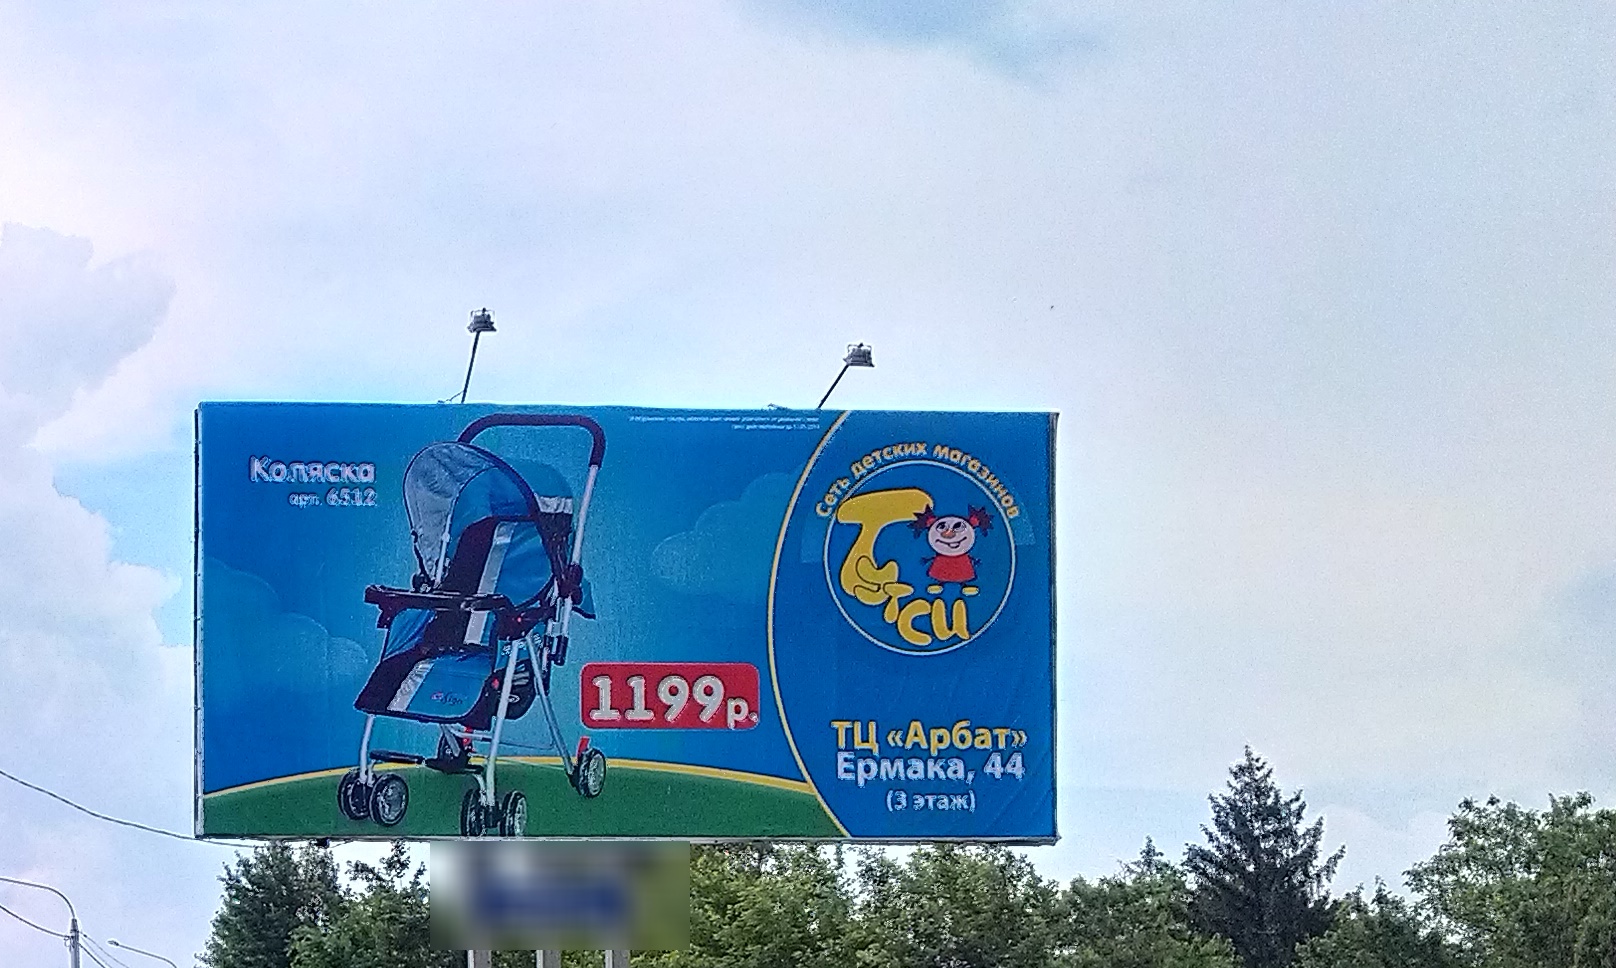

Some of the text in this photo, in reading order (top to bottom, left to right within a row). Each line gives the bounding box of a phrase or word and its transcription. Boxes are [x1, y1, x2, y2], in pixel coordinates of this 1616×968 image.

[250, 455, 376, 483] Коляска
[816, 442, 1019, 518] Сеть детских магазинов
[288, 487, 377, 508] арт. 6512
[831, 720, 1028, 756] ТЦ «Арбат»
[837, 751, 1026, 787] Ермака, 44
[886, 790, 976, 812] (3 этаж)
